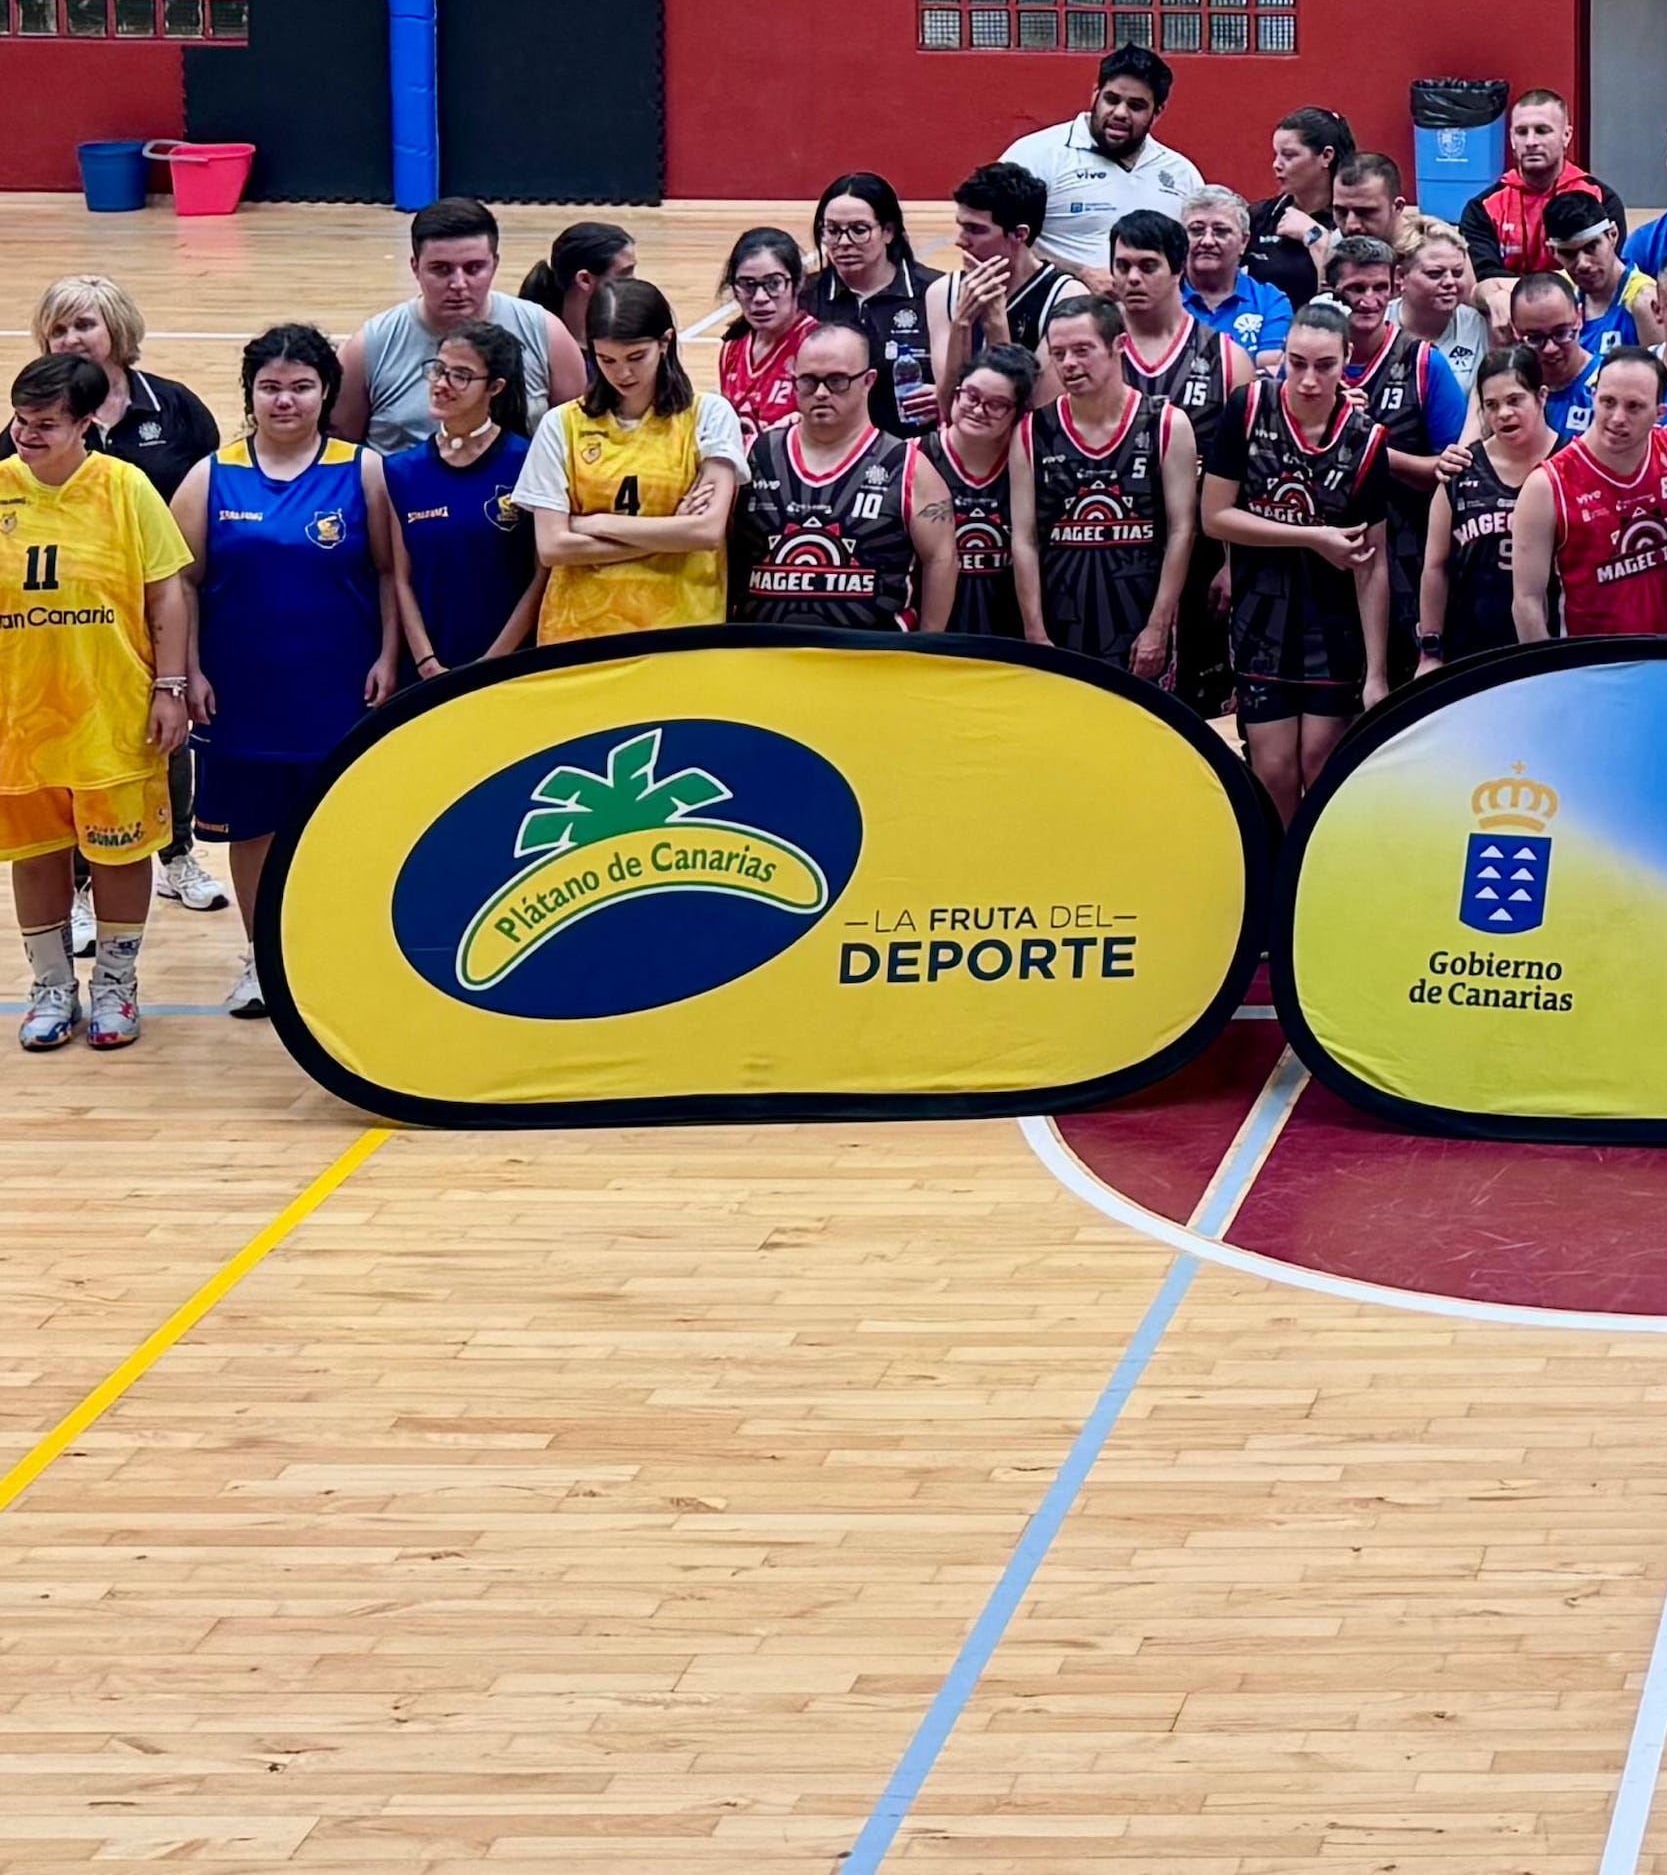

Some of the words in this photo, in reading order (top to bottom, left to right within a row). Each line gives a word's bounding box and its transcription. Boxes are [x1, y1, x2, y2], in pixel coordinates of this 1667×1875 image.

[766, 379, 794, 405] 12
[1182, 381, 1208, 406] 15
[1380, 387, 1404, 411] 13
[1132, 457, 1148, 480] 5
[614, 475, 640, 516] 4
[851, 492, 884, 520] 10
[1112, 524, 1154, 541] TIAS
[23, 544, 59, 591] 11
[1596, 549, 1657, 584] MAGEC
[750, 574, 816, 592] MAGEC
[824, 573, 875, 593] TIAS
[493, 868, 601, 944] Plátano
[607, 852, 643, 884] de
[650, 841, 777, 884] Canarias
[874, 909, 917, 933] LA
[929, 906, 1038, 931] FRUTA
[1050, 904, 1113, 929] DEL
[838, 936, 1137, 985] DEPORTE
[1428, 950, 1564, 982] Gobierno
[1408, 979, 1443, 1007] de
[1447, 982, 1575, 1014] Canarias
